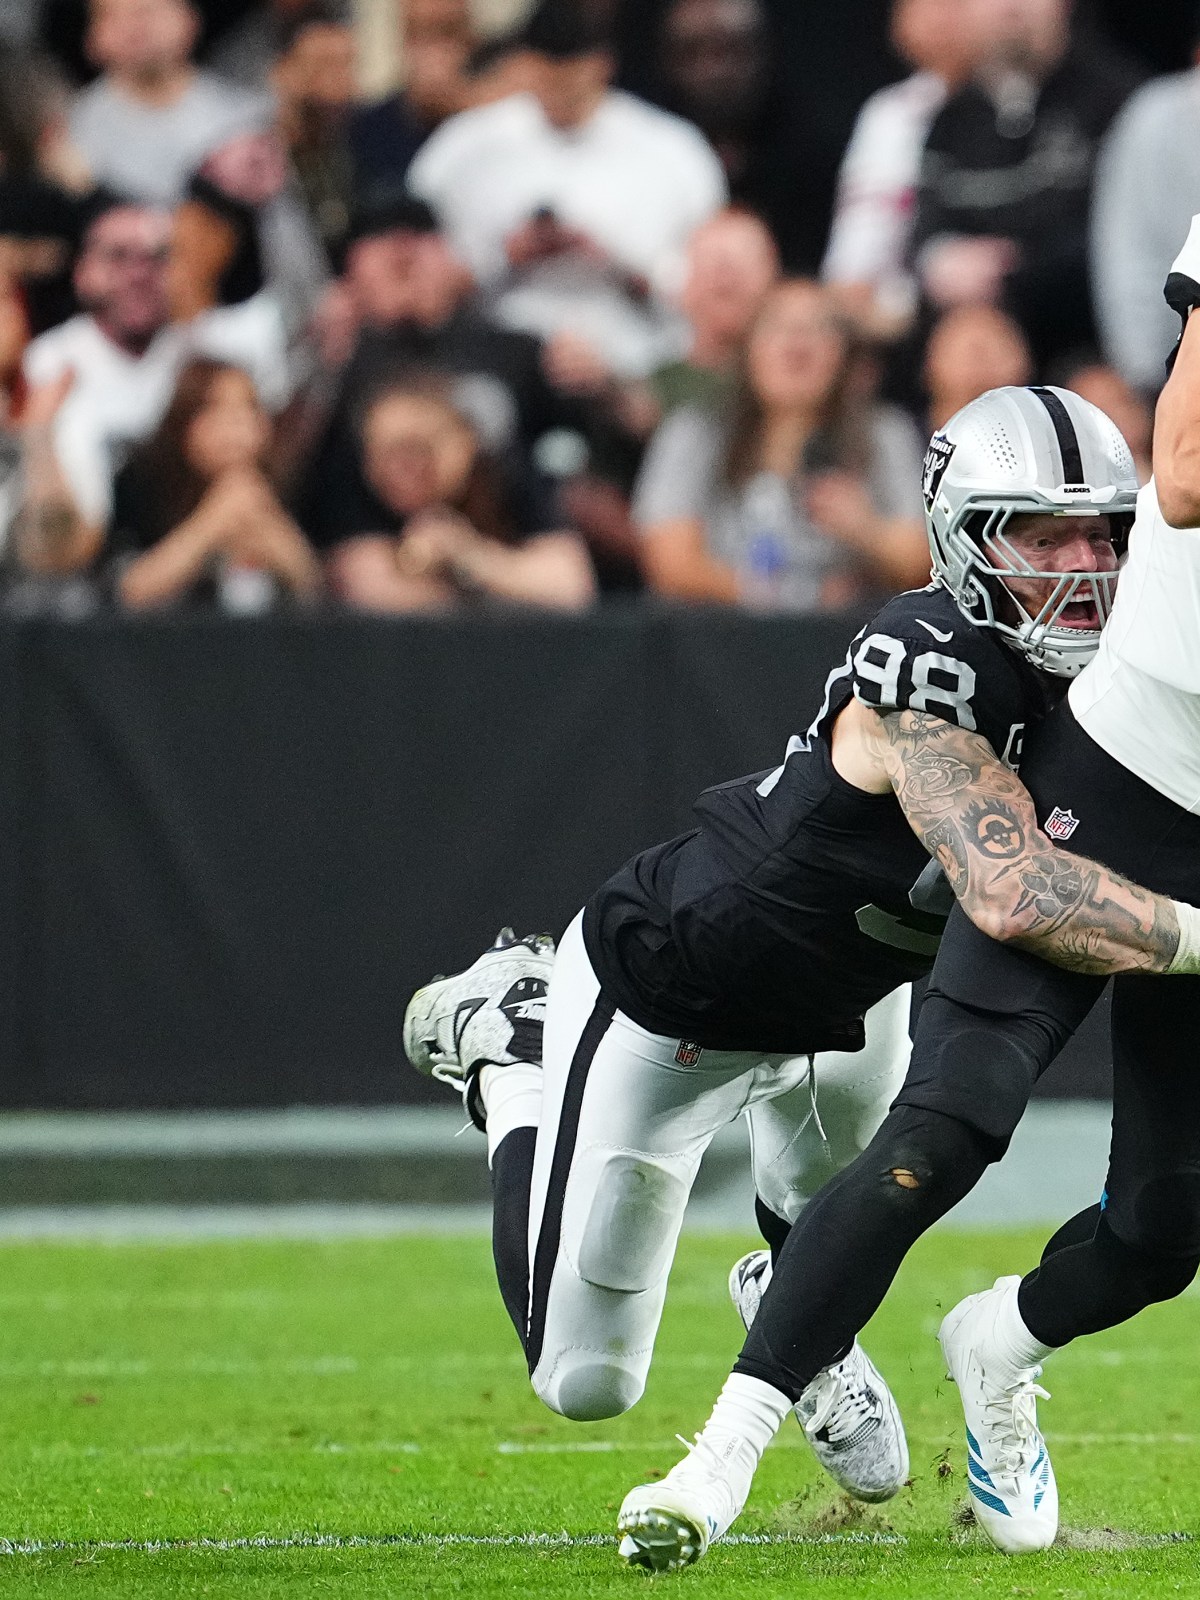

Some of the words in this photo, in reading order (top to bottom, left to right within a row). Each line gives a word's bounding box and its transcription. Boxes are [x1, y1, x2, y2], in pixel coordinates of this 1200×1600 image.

[853, 633, 977, 732] 98
[1049, 818, 1069, 836] NFL
[677, 1049, 696, 1064] NFL
